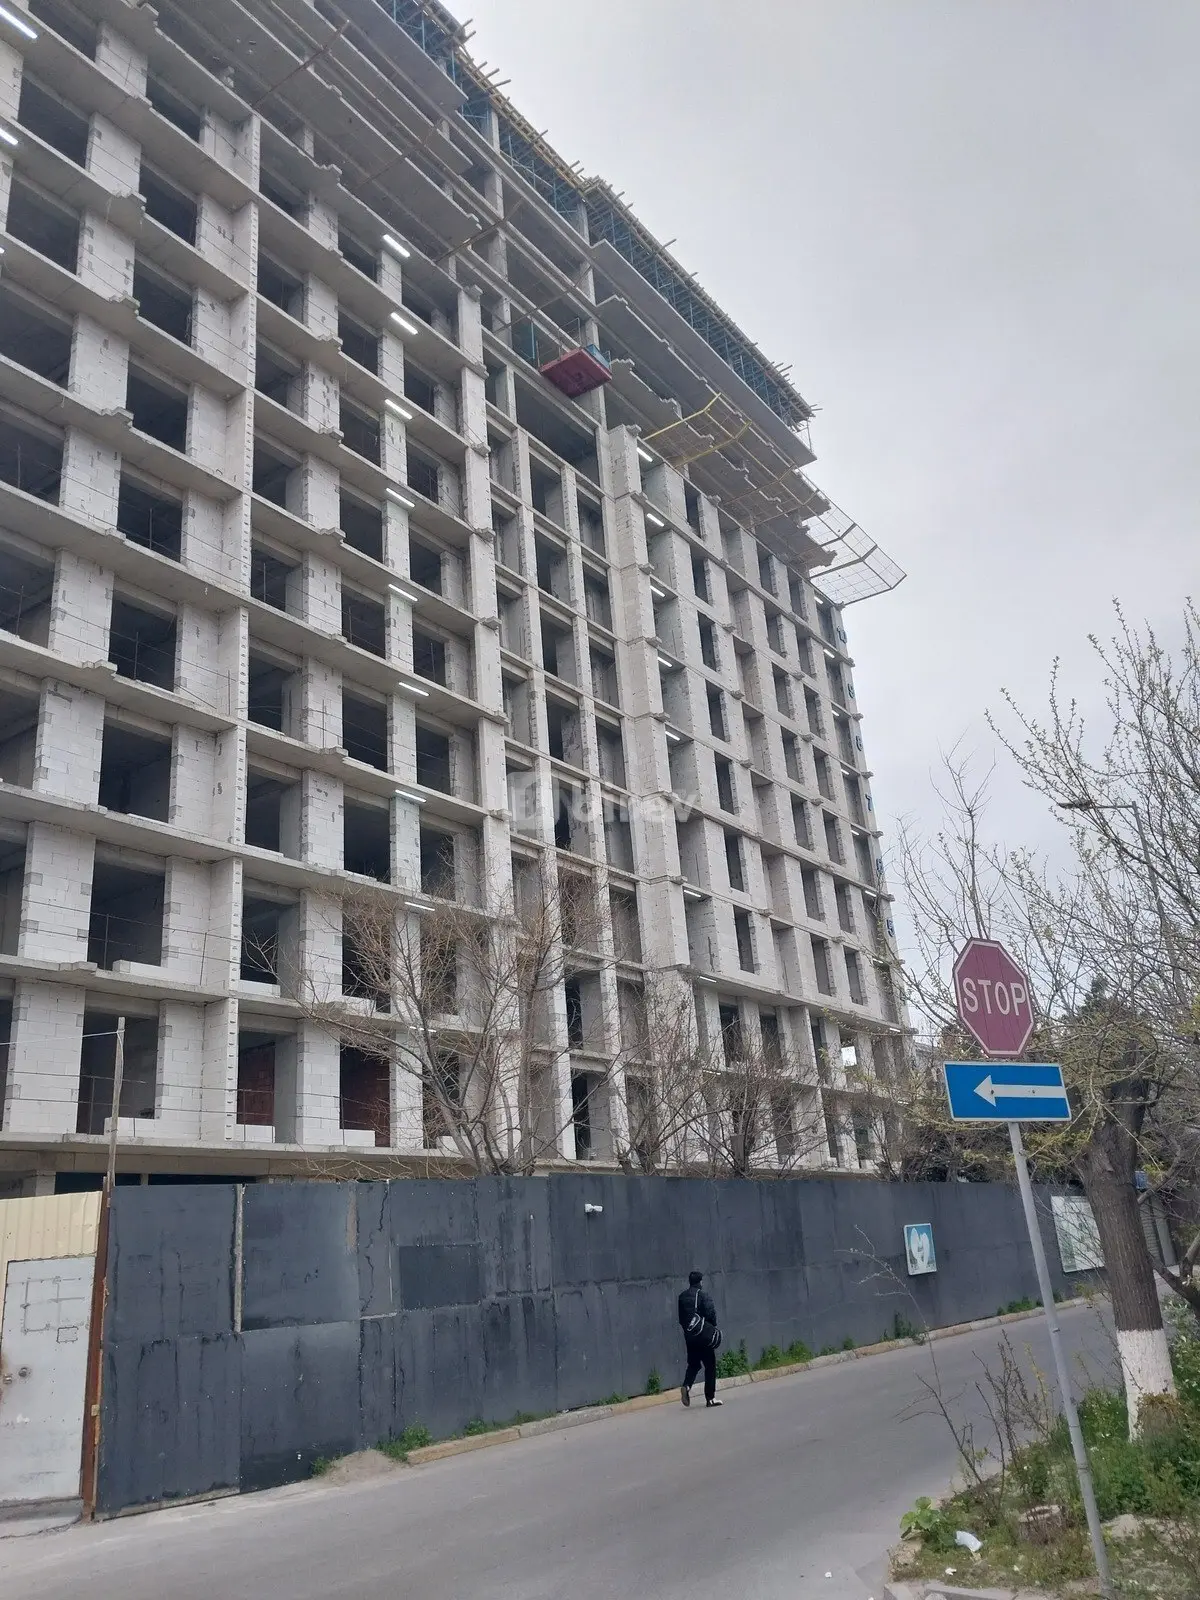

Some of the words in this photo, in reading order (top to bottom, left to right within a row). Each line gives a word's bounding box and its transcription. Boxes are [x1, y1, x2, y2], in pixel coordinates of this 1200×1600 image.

[864, 793, 873, 811] 7
[886, 919, 895, 938] 5
[962, 977, 1026, 1016] STOP
